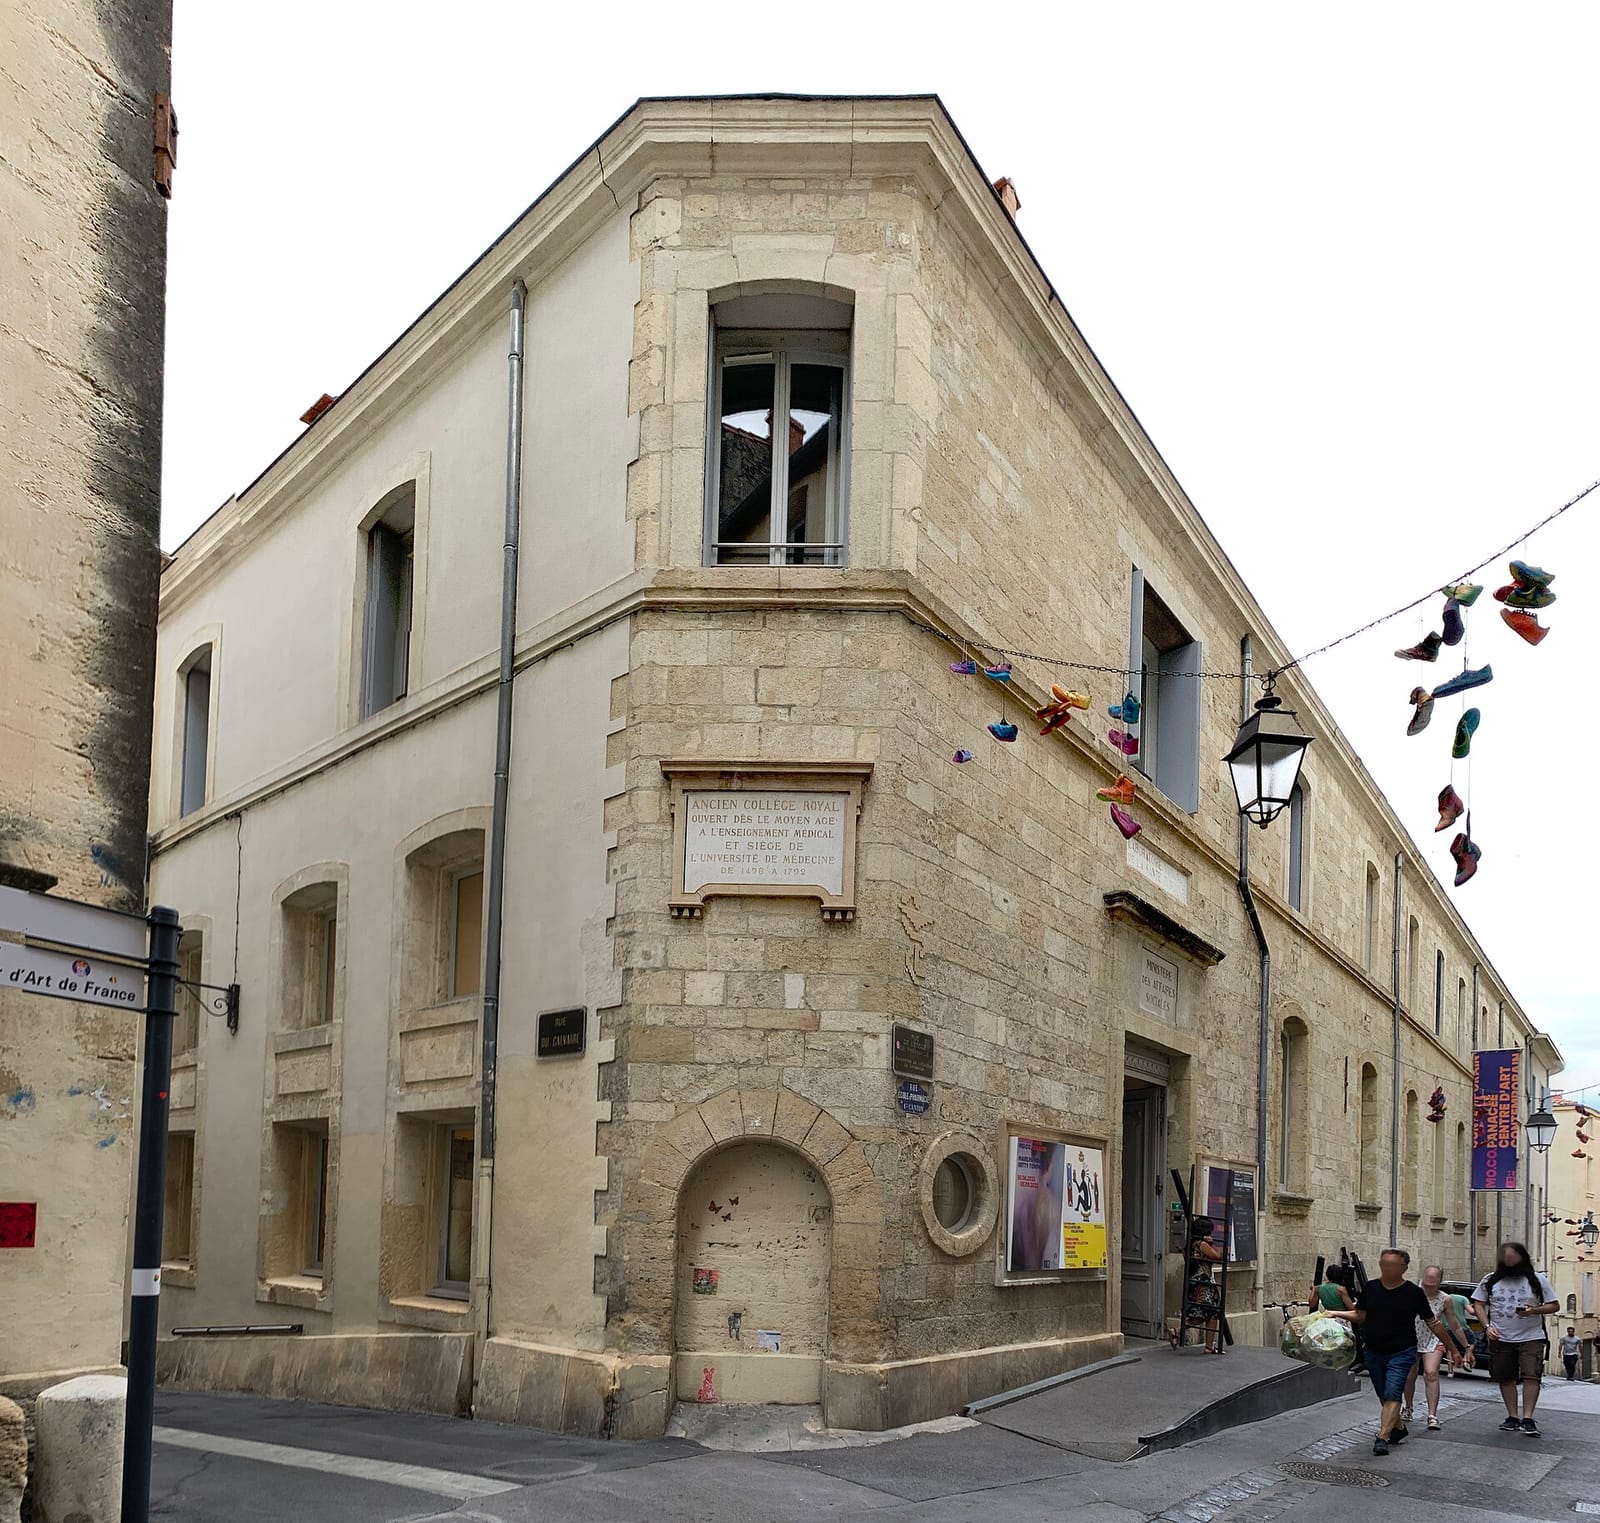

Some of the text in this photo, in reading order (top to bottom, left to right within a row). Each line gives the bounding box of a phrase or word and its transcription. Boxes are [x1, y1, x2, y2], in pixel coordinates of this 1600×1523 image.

[691, 799, 738, 810] ANCIEN
[803, 800, 840, 812] ROYAL
[691, 814, 728, 824] OUVERT
[757, 815, 770, 824] LE
[774, 815, 811, 825] MOYEN
[711, 827, 789, 838] L'ENSEIGNEMENT
[725, 841, 740, 850] ET
[789, 842, 804, 851] DE
[765, 855, 778, 864] DE
[720, 866, 735, 875] DE
[9, 968, 136, 1002] d'Art de France
[1498, 1066, 1511, 1148] CENTRE D'ART
